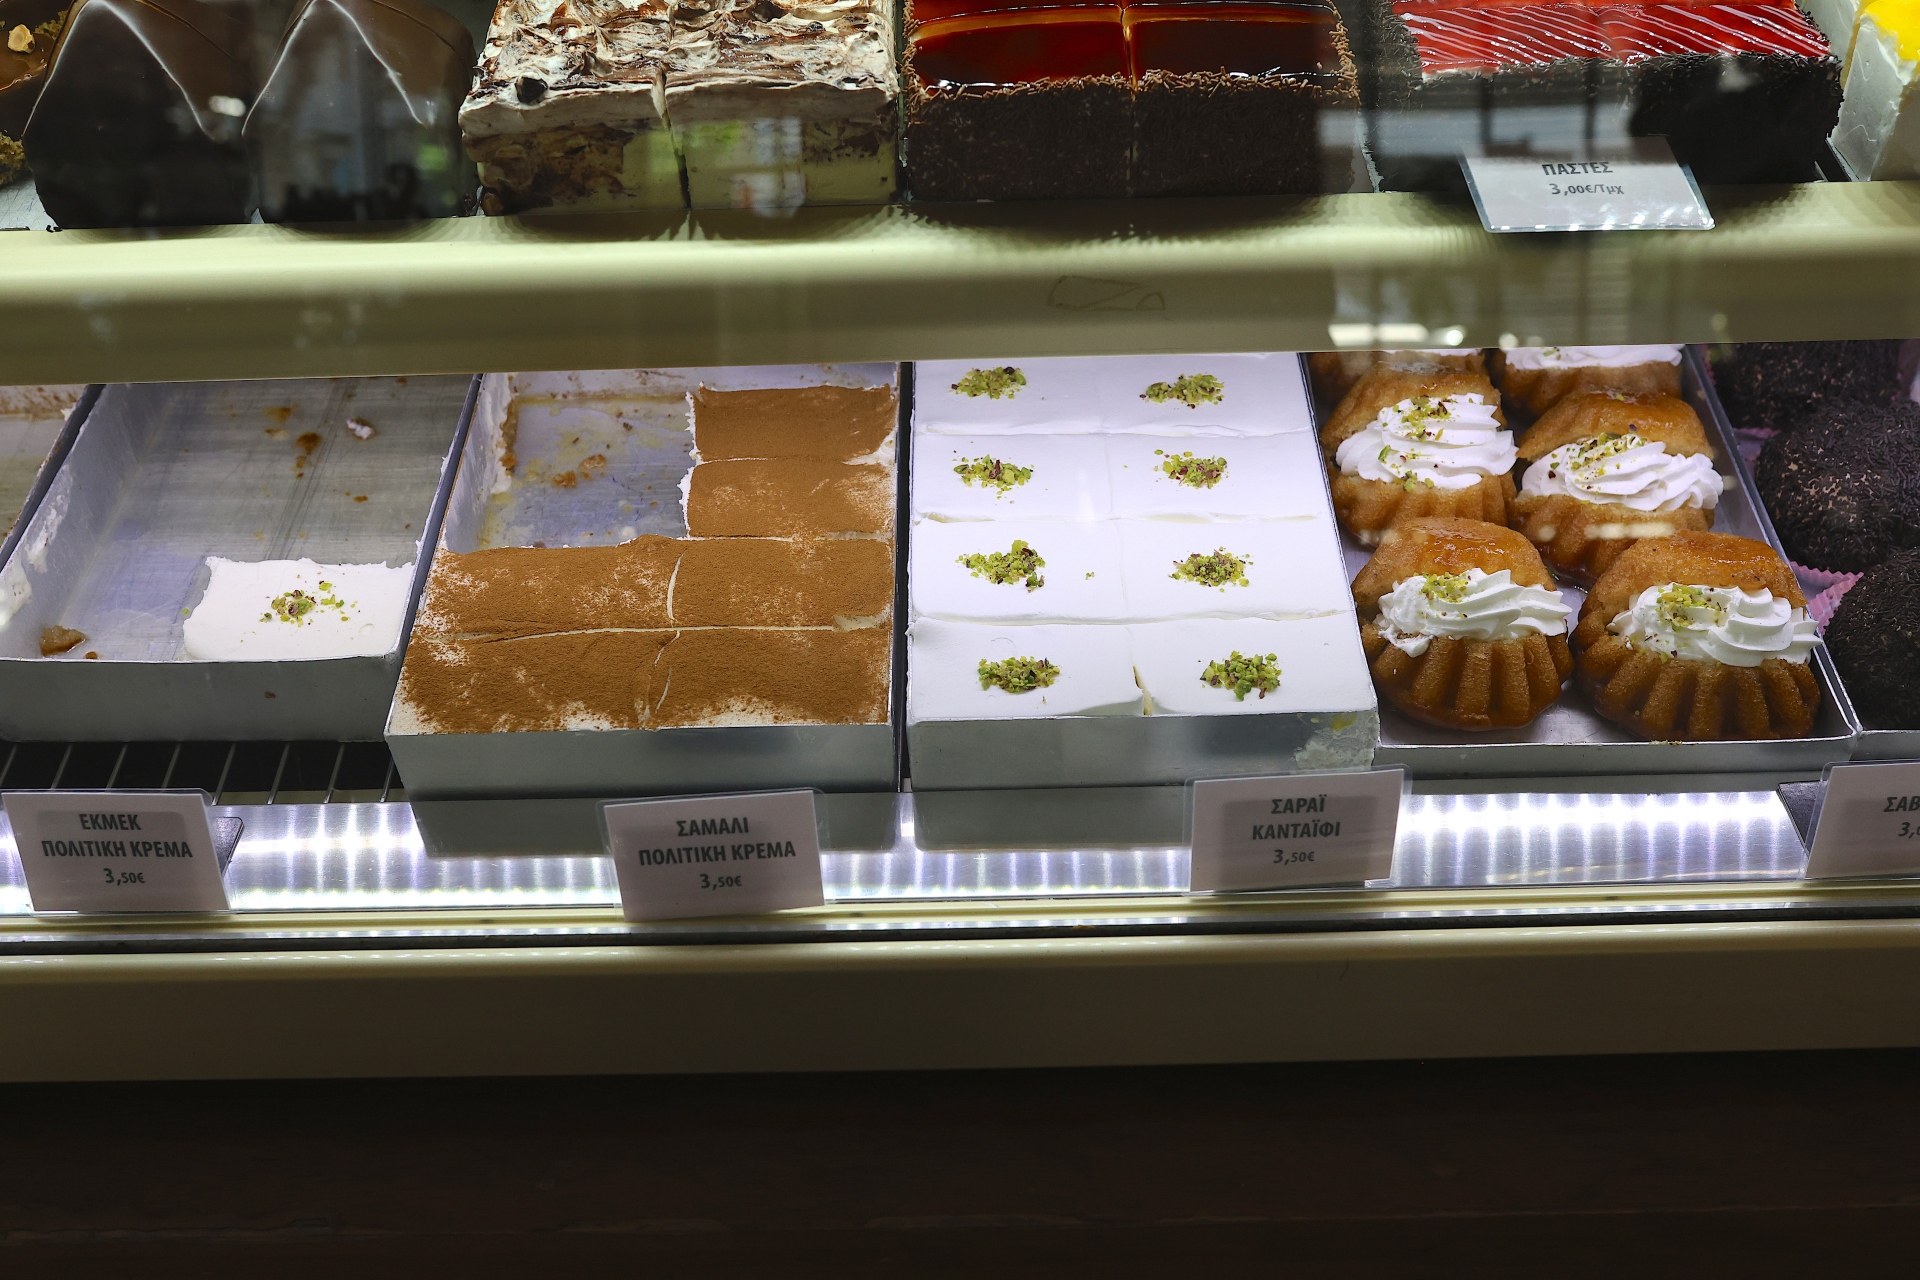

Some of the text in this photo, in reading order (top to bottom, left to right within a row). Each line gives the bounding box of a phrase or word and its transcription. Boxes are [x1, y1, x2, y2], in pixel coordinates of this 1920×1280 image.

[1541, 161, 1613, 176] ΠΑΣΤΕΣ
[1271, 794, 1327, 815] ΣΑΡΑΪ
[79, 813, 142, 831] ΕΚΜΕΚ
[676, 816, 750, 837] ΣΑΜΑΛΙ
[1252, 819, 1341, 840] ΚΑΝΤΑΪΦΙ
[41, 840, 194, 858] ΠΟΛΙΤΙΚΗ ΚΡΕΜΑ
[638, 840, 797, 866] ΠΟΛΙΤΙΚΗ ΚΡΕΜΑ
[1273, 849, 1315, 866] 3,50€
[103, 867, 146, 886] 3,50€
[699, 873, 742, 891] 3,50€
